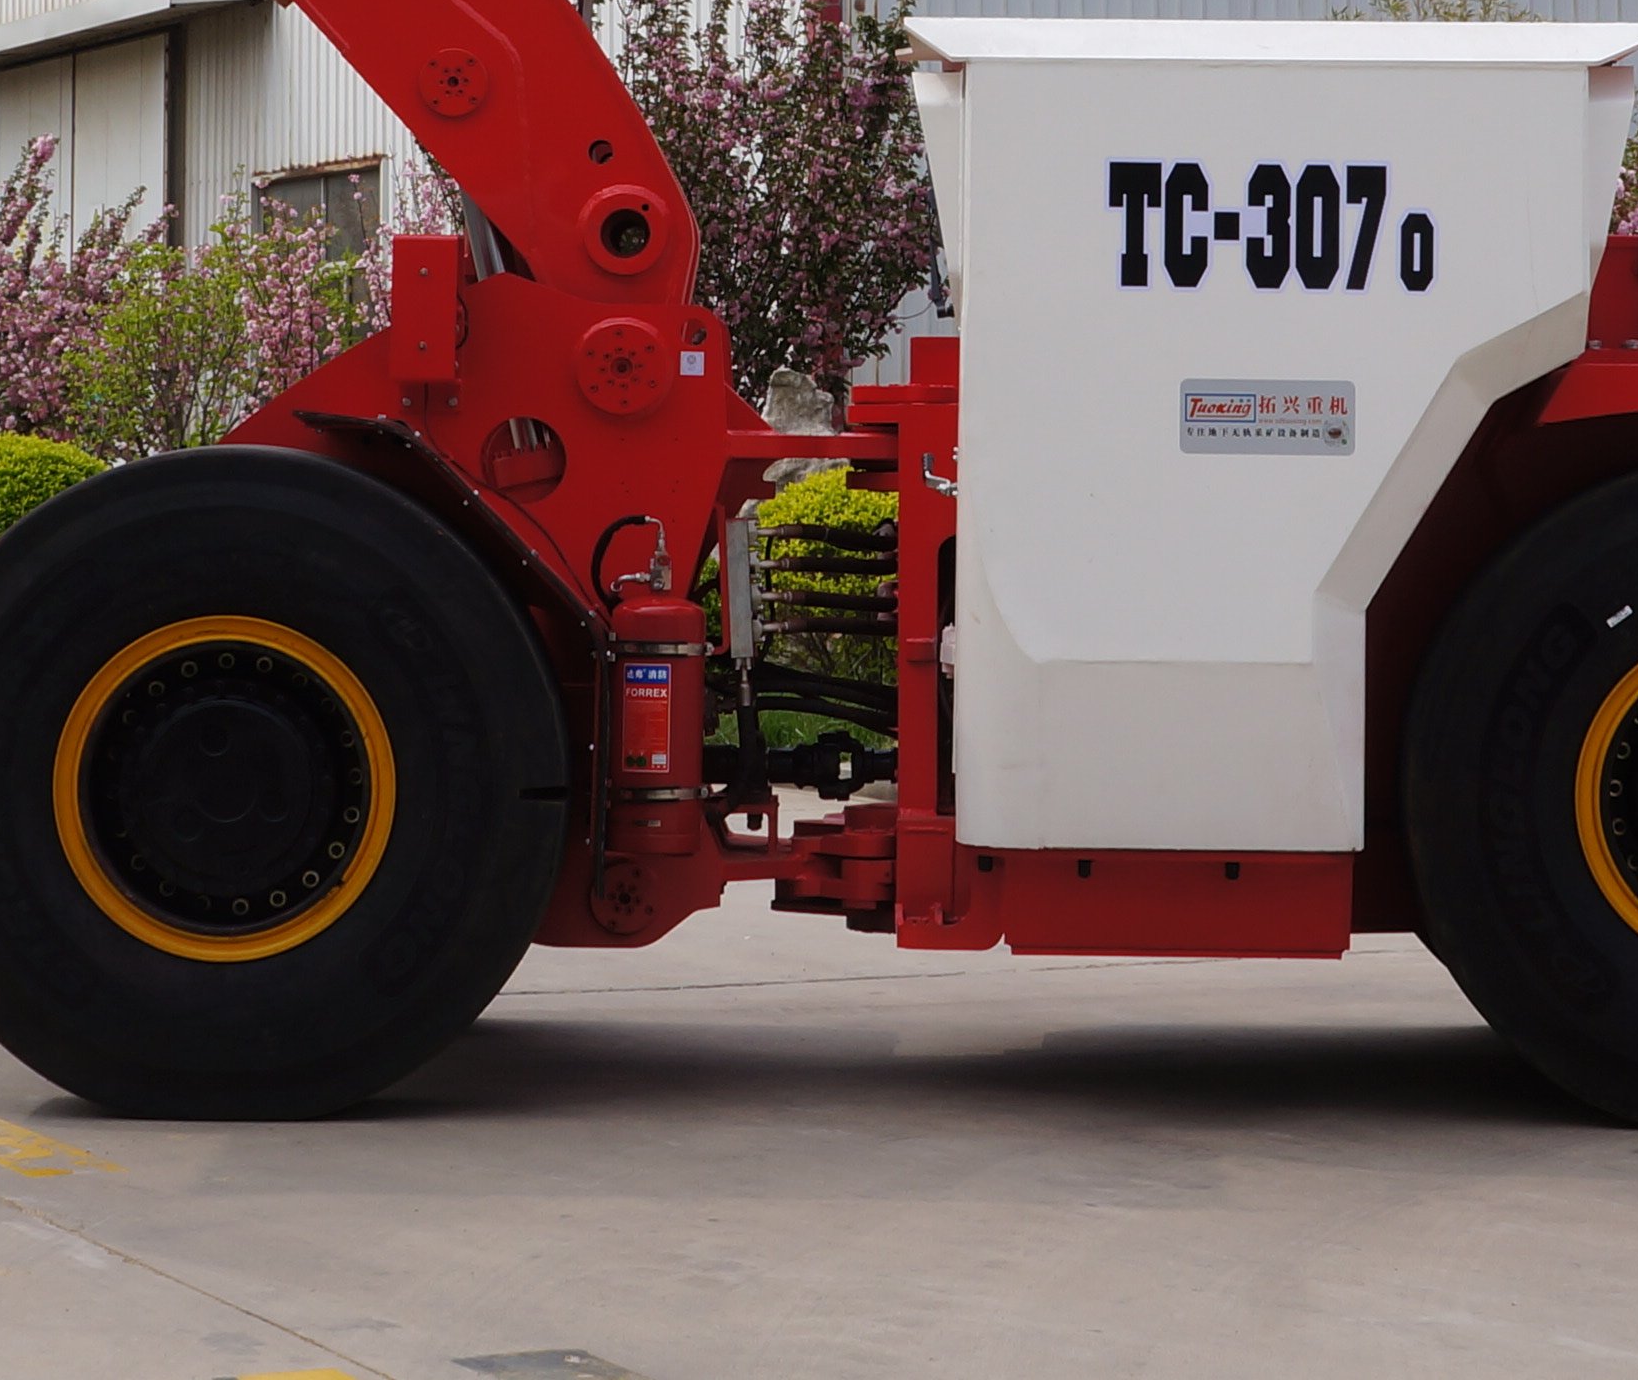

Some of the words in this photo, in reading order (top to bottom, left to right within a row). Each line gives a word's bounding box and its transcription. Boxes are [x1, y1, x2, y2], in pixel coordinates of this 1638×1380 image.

[1189, 397, 1252, 418] Tuoxing
[1258, 395, 1349, 416] 拓兴重机
[625, 687, 668, 698] FORREX
